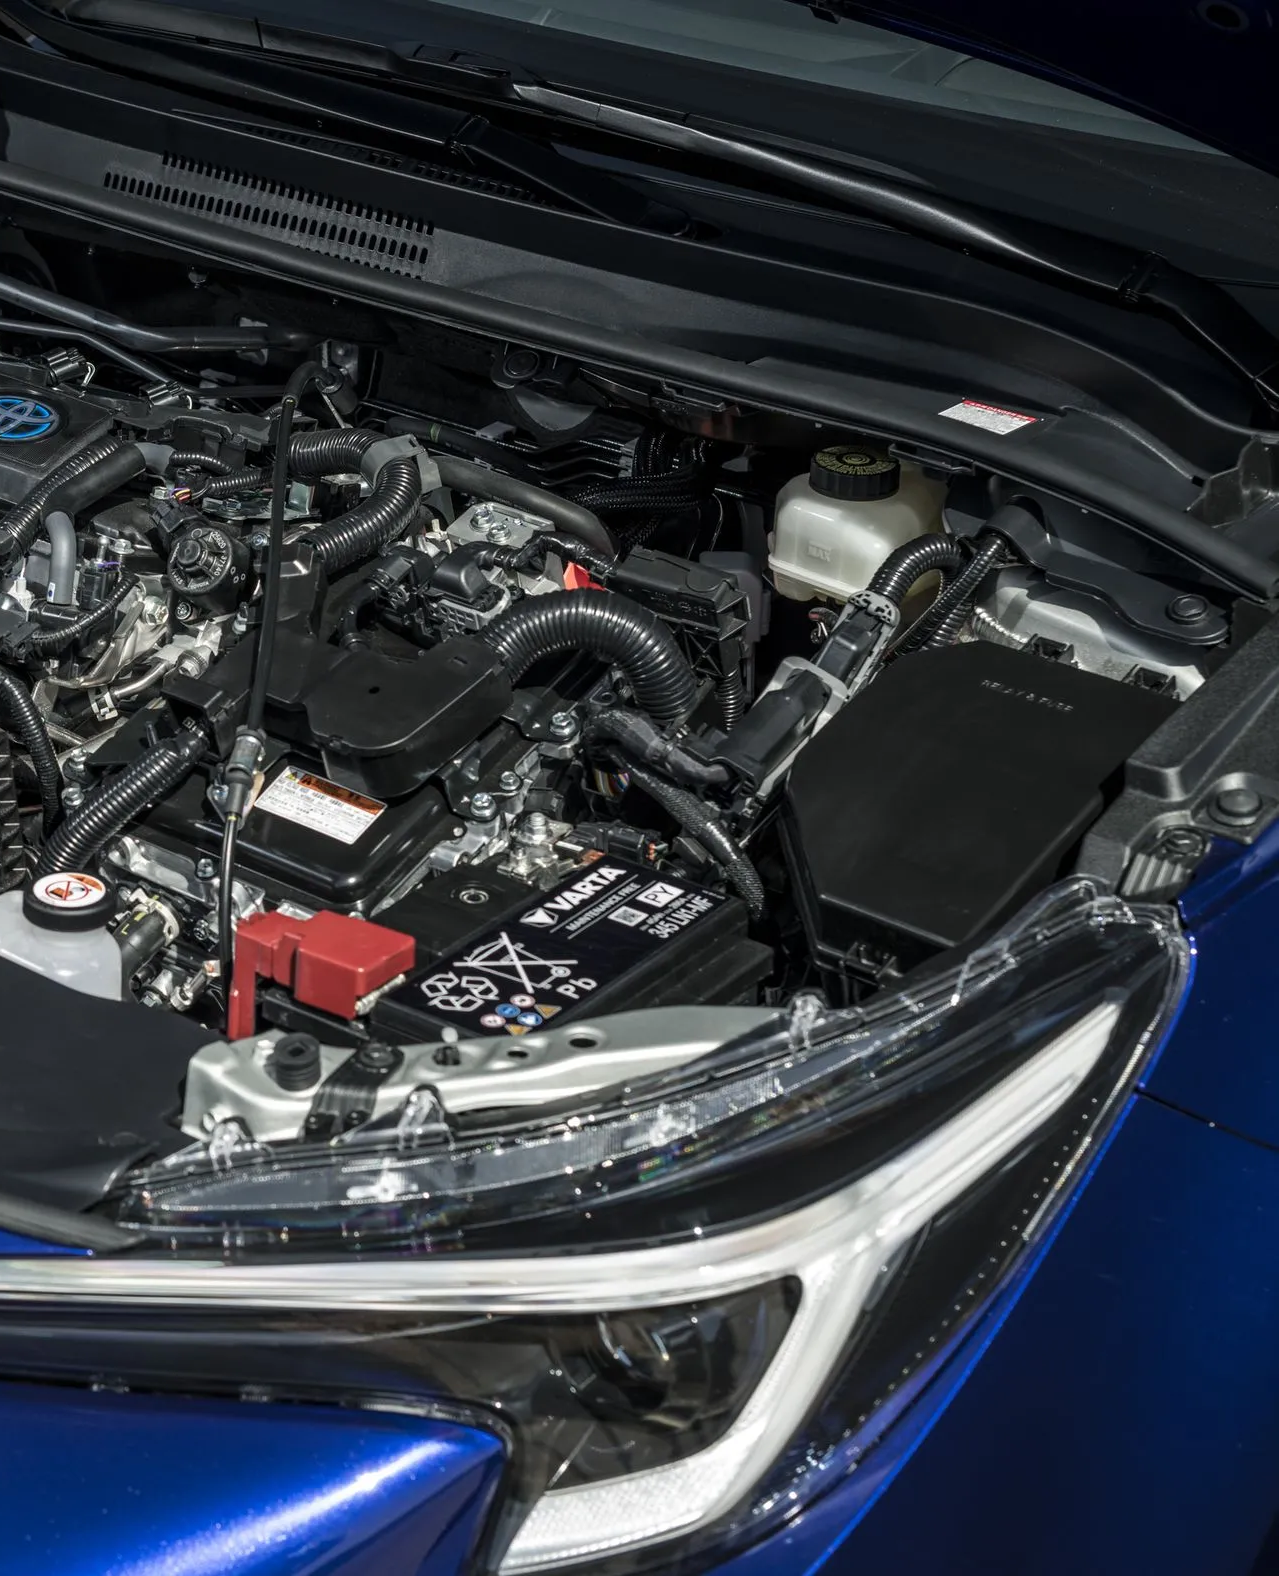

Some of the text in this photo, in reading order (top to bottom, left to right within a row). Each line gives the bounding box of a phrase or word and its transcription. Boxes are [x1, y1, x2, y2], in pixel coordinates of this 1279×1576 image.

[545, 865, 627, 911] VARTA
[644, 885, 674, 903] PY
[565, 882, 642, 931] MAINTENANCE FREE
[648, 920, 679, 939] 345
[556, 977, 597, 999] Pb
